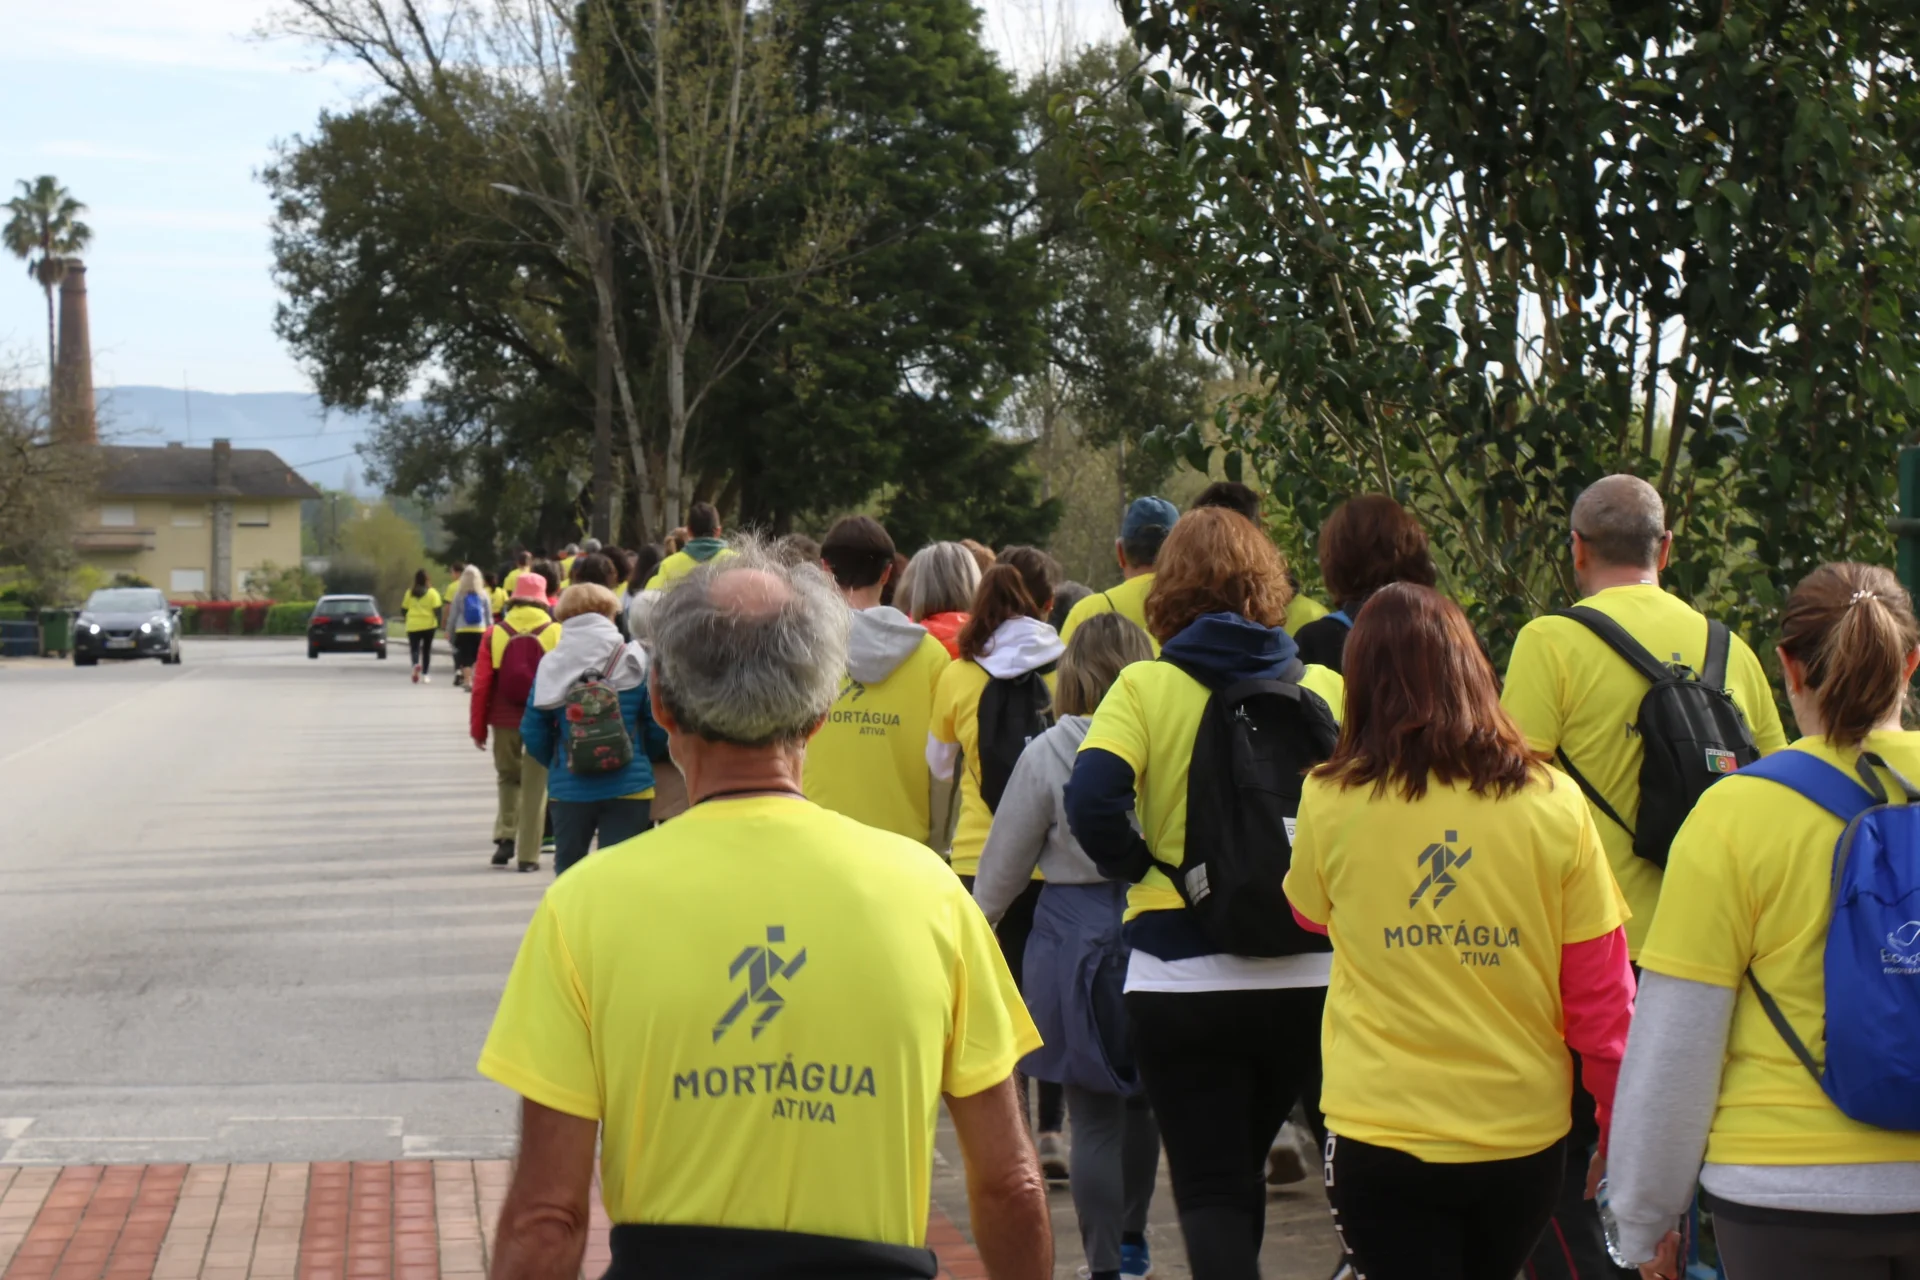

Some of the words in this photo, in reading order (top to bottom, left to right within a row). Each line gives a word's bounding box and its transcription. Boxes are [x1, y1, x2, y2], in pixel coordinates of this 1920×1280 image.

[859, 726, 886, 736] ATIVA
[1460, 951, 1501, 967] TIVA
[673, 1052, 877, 1101] MORTÁGUA
[771, 1096, 836, 1124] ATIVA
